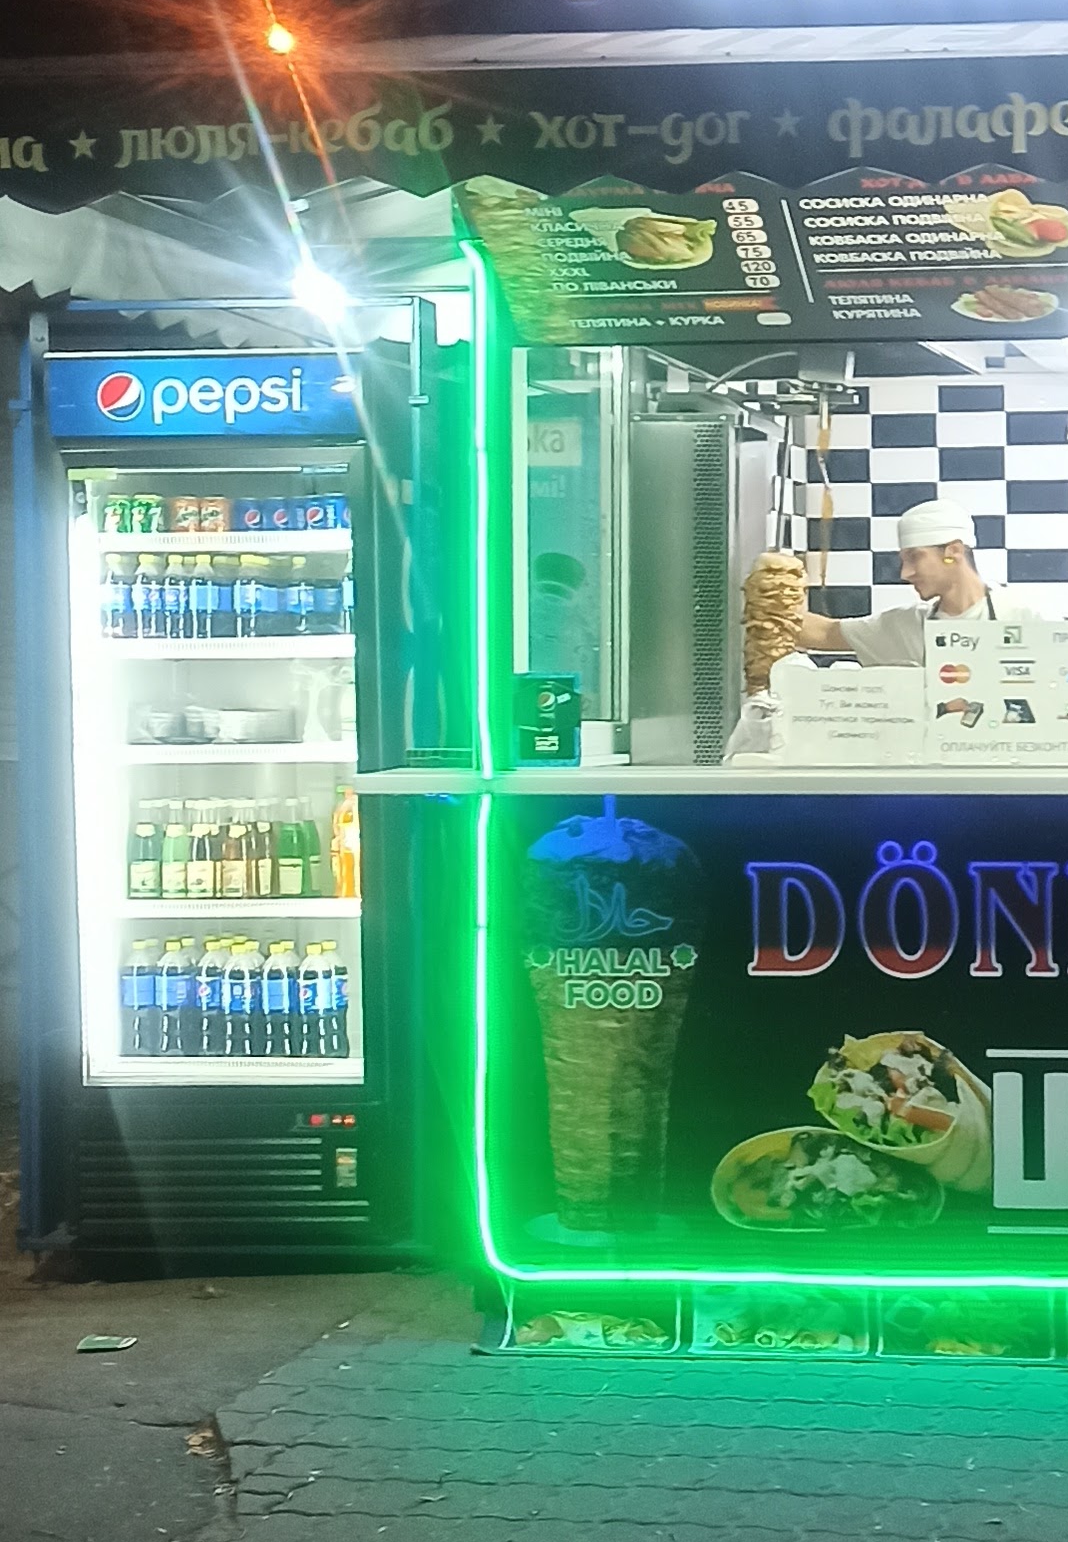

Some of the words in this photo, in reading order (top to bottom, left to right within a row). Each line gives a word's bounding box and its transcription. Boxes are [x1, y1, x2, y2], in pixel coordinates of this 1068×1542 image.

[800, 196, 884, 209] СОСИСКА
[733, 217, 754, 227] 55
[804, 216, 888, 228] СОСИСКА
[737, 232, 756, 242] 65
[809, 233, 901, 246] КОВБАСКА
[743, 247, 762, 257] 75
[813, 250, 905, 263] КОВБАСКА
[744, 262, 770, 272] 120
[670, 315, 725, 326] КУРКА
[153, 367, 303, 425] pepsi
[950, 633, 980, 649] Pay
[1003, 666, 1032, 677] VISA
[557, 948, 669, 977] HALAL
[565, 980, 663, 1009] FOOD
